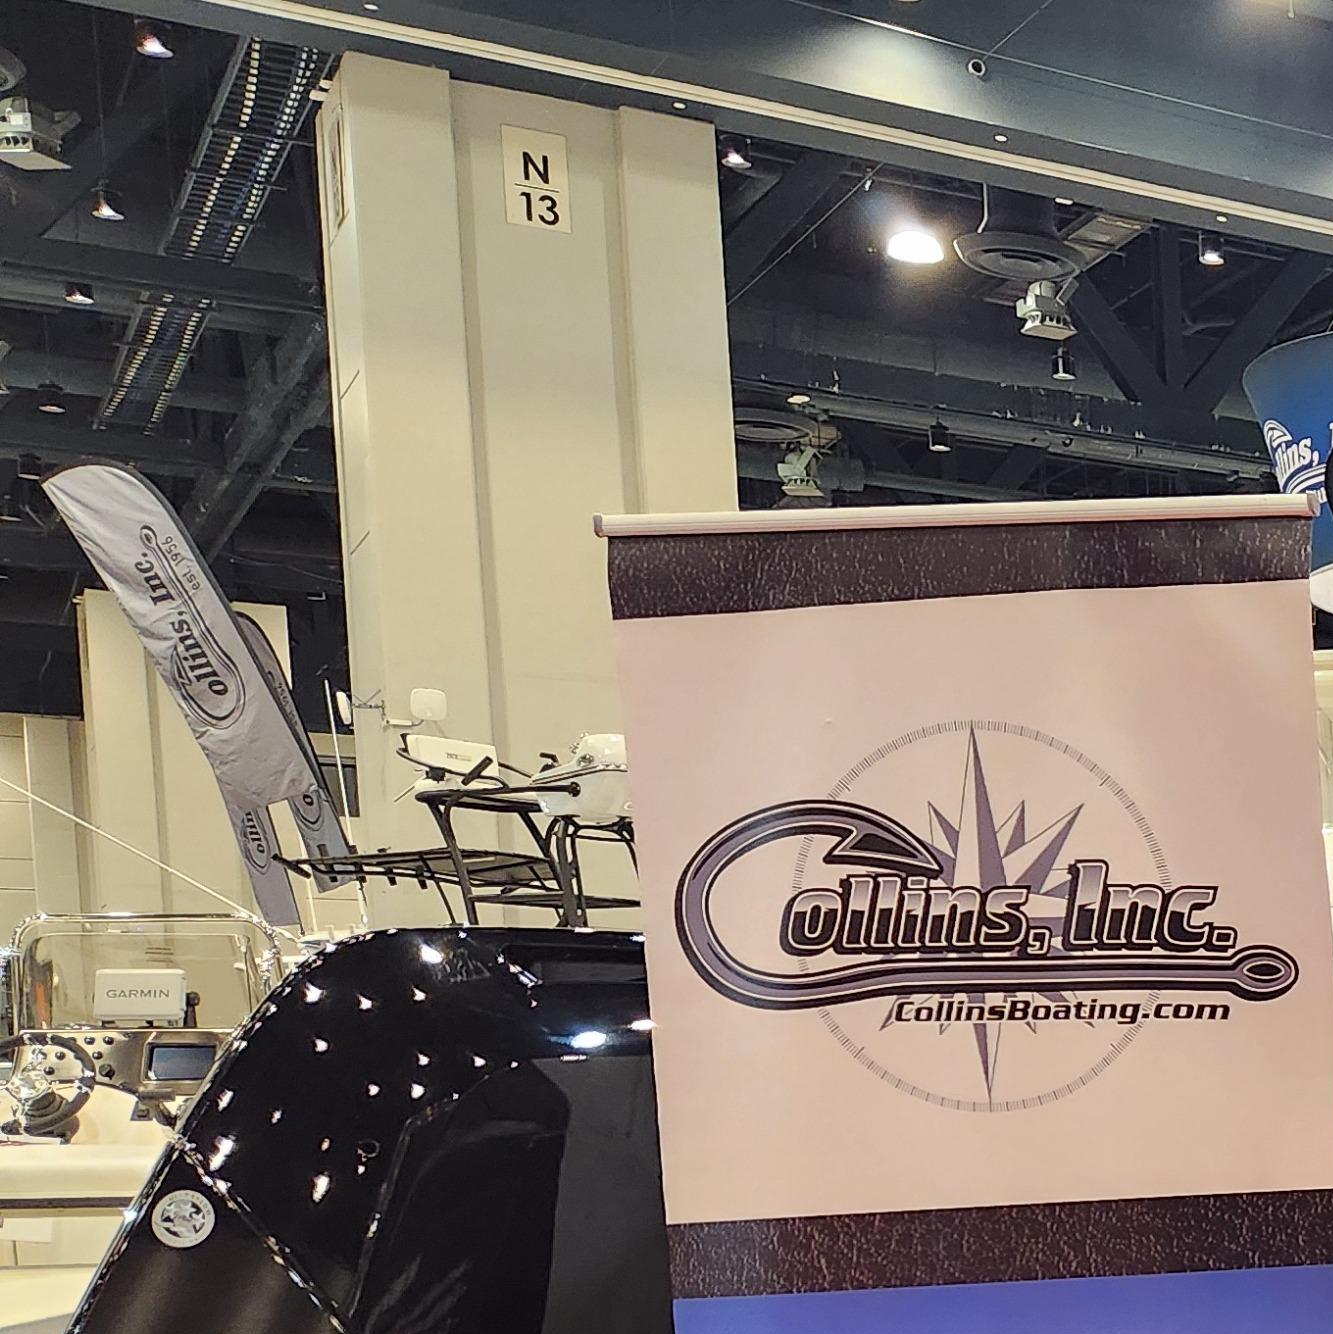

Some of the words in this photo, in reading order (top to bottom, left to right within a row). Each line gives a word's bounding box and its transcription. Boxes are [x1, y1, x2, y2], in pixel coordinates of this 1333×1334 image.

[522, 151, 549, 184] N
[520, 192, 560, 226] 13
[161, 535, 187, 568] 1956
[134, 551, 175, 606] Inc.
[675, 800, 1052, 1011] Collins,
[1066, 860, 1239, 954] Inc.
[105, 989, 170, 999] GARMIN
[893, 998, 1231, 1026] CollinsBoating.com
